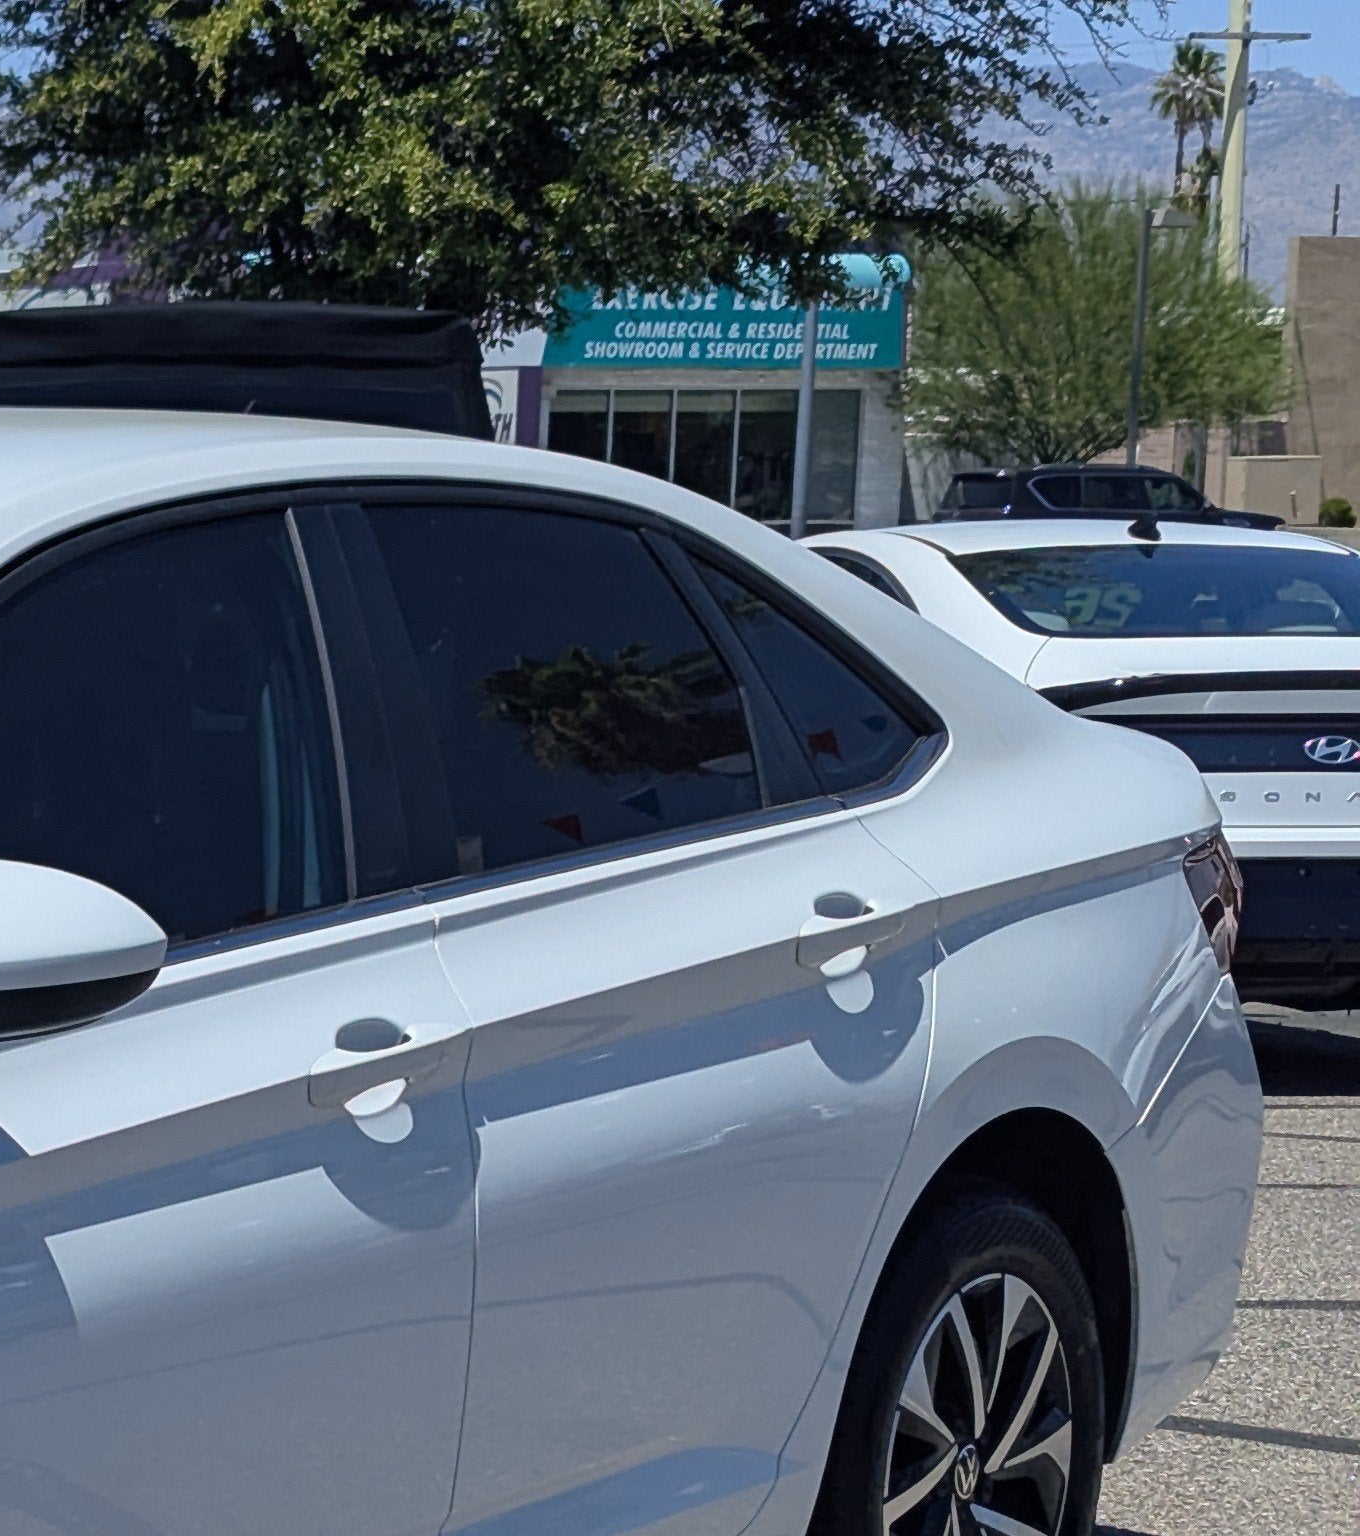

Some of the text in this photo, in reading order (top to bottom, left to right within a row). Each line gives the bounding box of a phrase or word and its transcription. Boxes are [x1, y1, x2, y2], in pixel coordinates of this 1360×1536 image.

[614, 321, 850, 340] COMMERCIAL & RESIDETIAL
[583, 341, 878, 360] SHOWROOM & SERVICE DEPRTMENT
